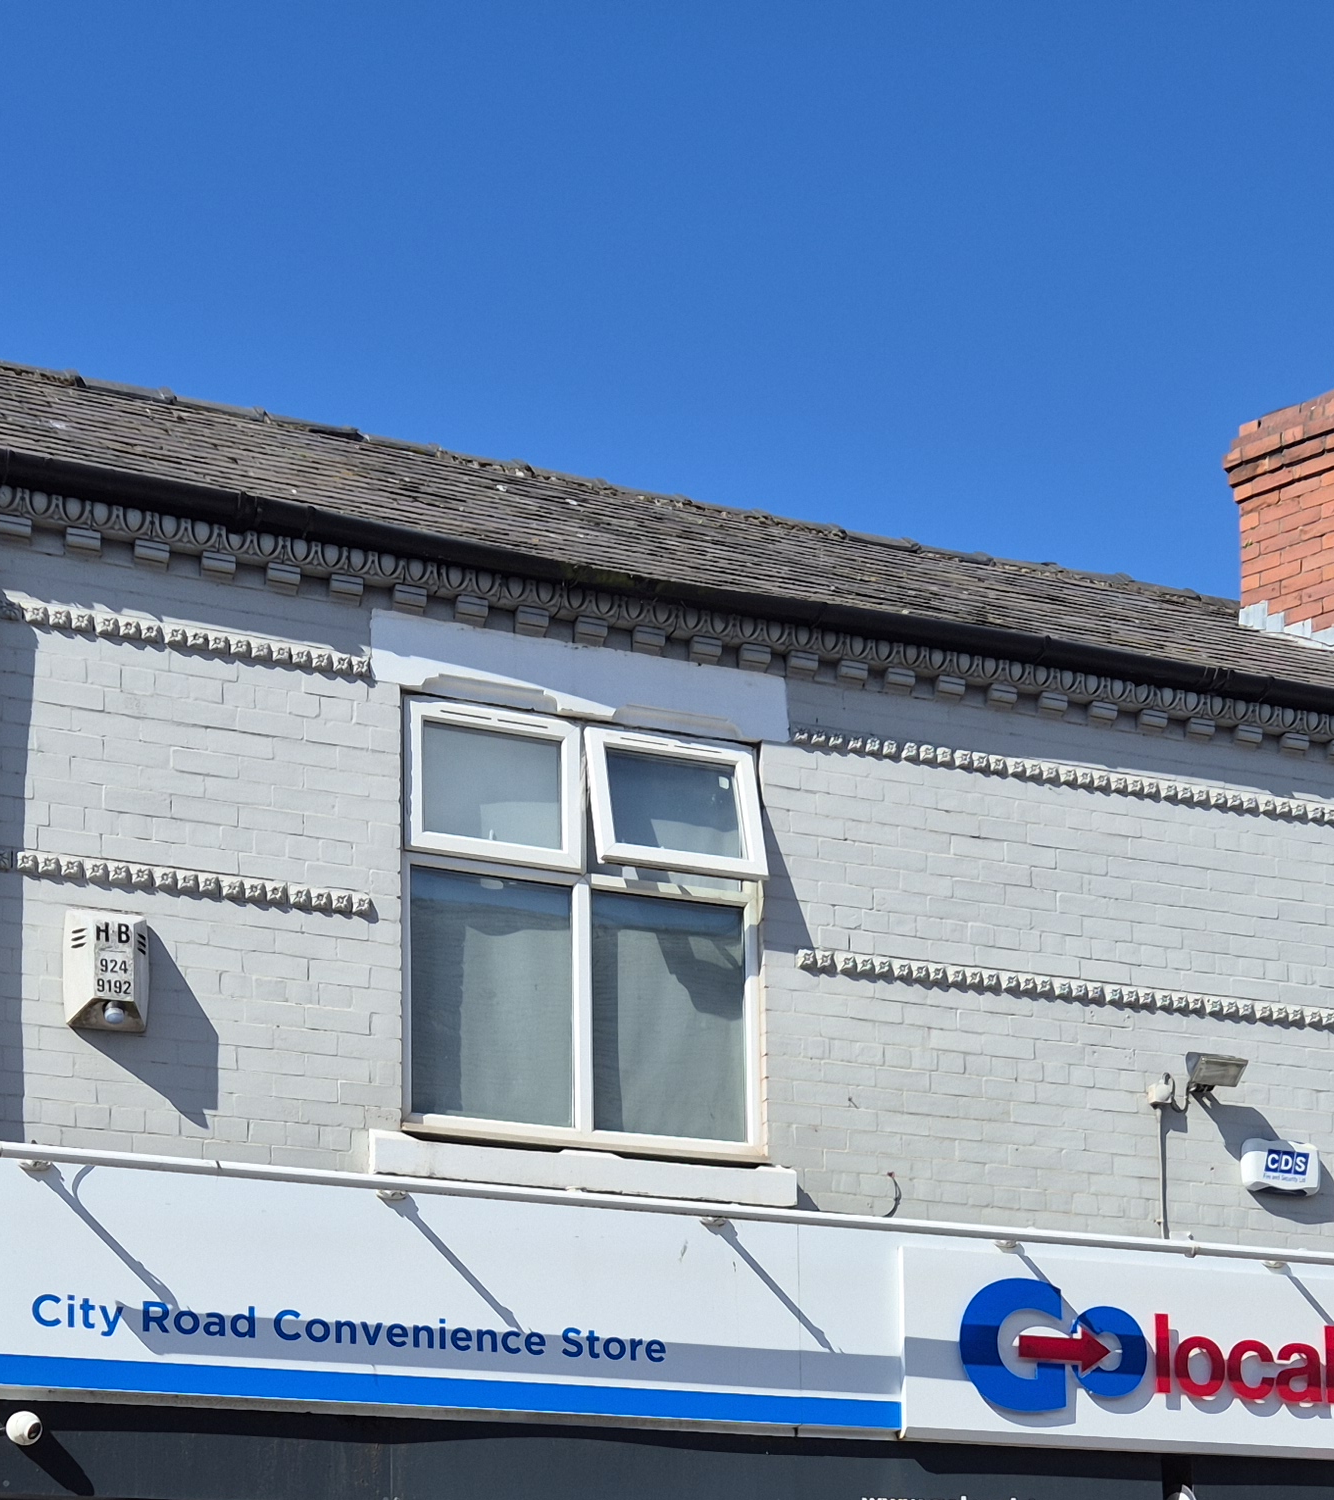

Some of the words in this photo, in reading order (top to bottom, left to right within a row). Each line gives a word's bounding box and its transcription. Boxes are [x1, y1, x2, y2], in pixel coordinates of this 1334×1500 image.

[100, 959, 128, 974] 924
[97, 978, 132, 995] 9192
[1268, 1153, 1306, 1172] CDS
[31, 1294, 123, 1337] City
[142, 1300, 256, 1340] Road
[273, 1309, 546, 1357] Convenience
[562, 1328, 666, 1363] Store
